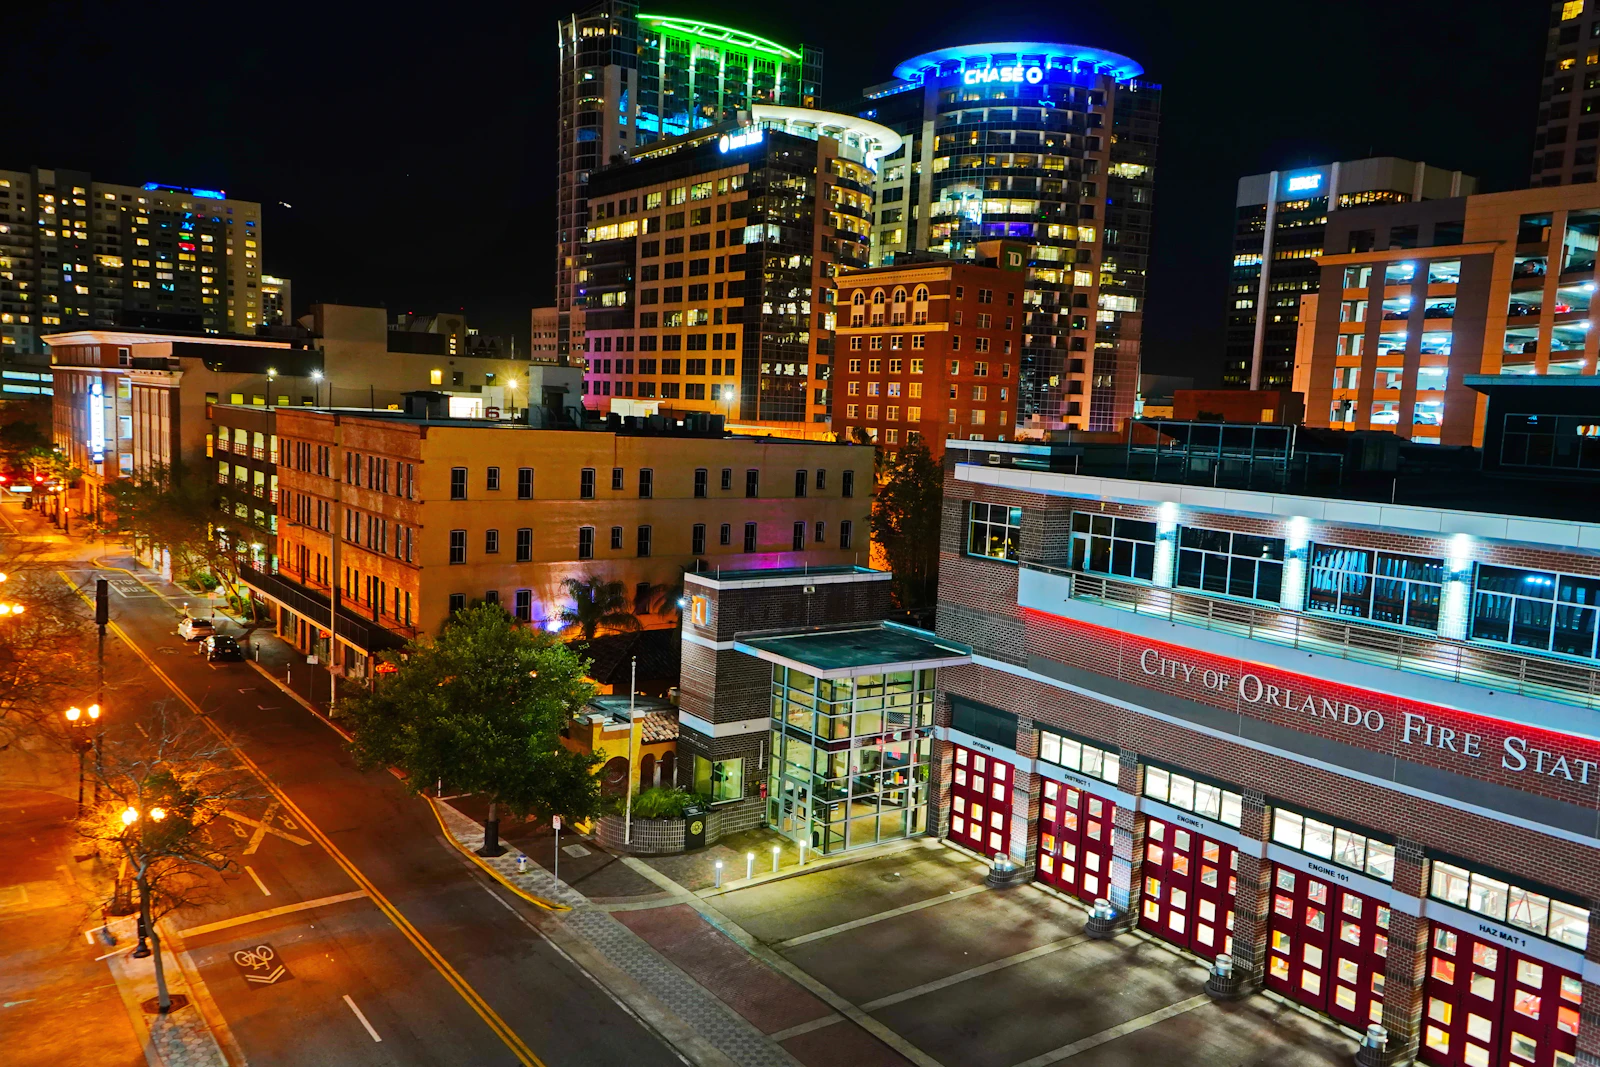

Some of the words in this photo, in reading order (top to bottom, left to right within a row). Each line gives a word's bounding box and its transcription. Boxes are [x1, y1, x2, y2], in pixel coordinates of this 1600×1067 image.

[964, 67, 1025, 84] CHASE
[1007, 251, 1022, 267] TD
[972, 740, 991, 751] DIVISION
[1064, 773, 1087, 787] DISTRICT
[1176, 814, 1200, 828] ENGINE
[1308, 862, 1336, 877] ENGINE
[1337, 872, 1349, 882] 101
[1479, 924, 1498, 937] HAZ
[1499, 931, 1519, 944] MAT
